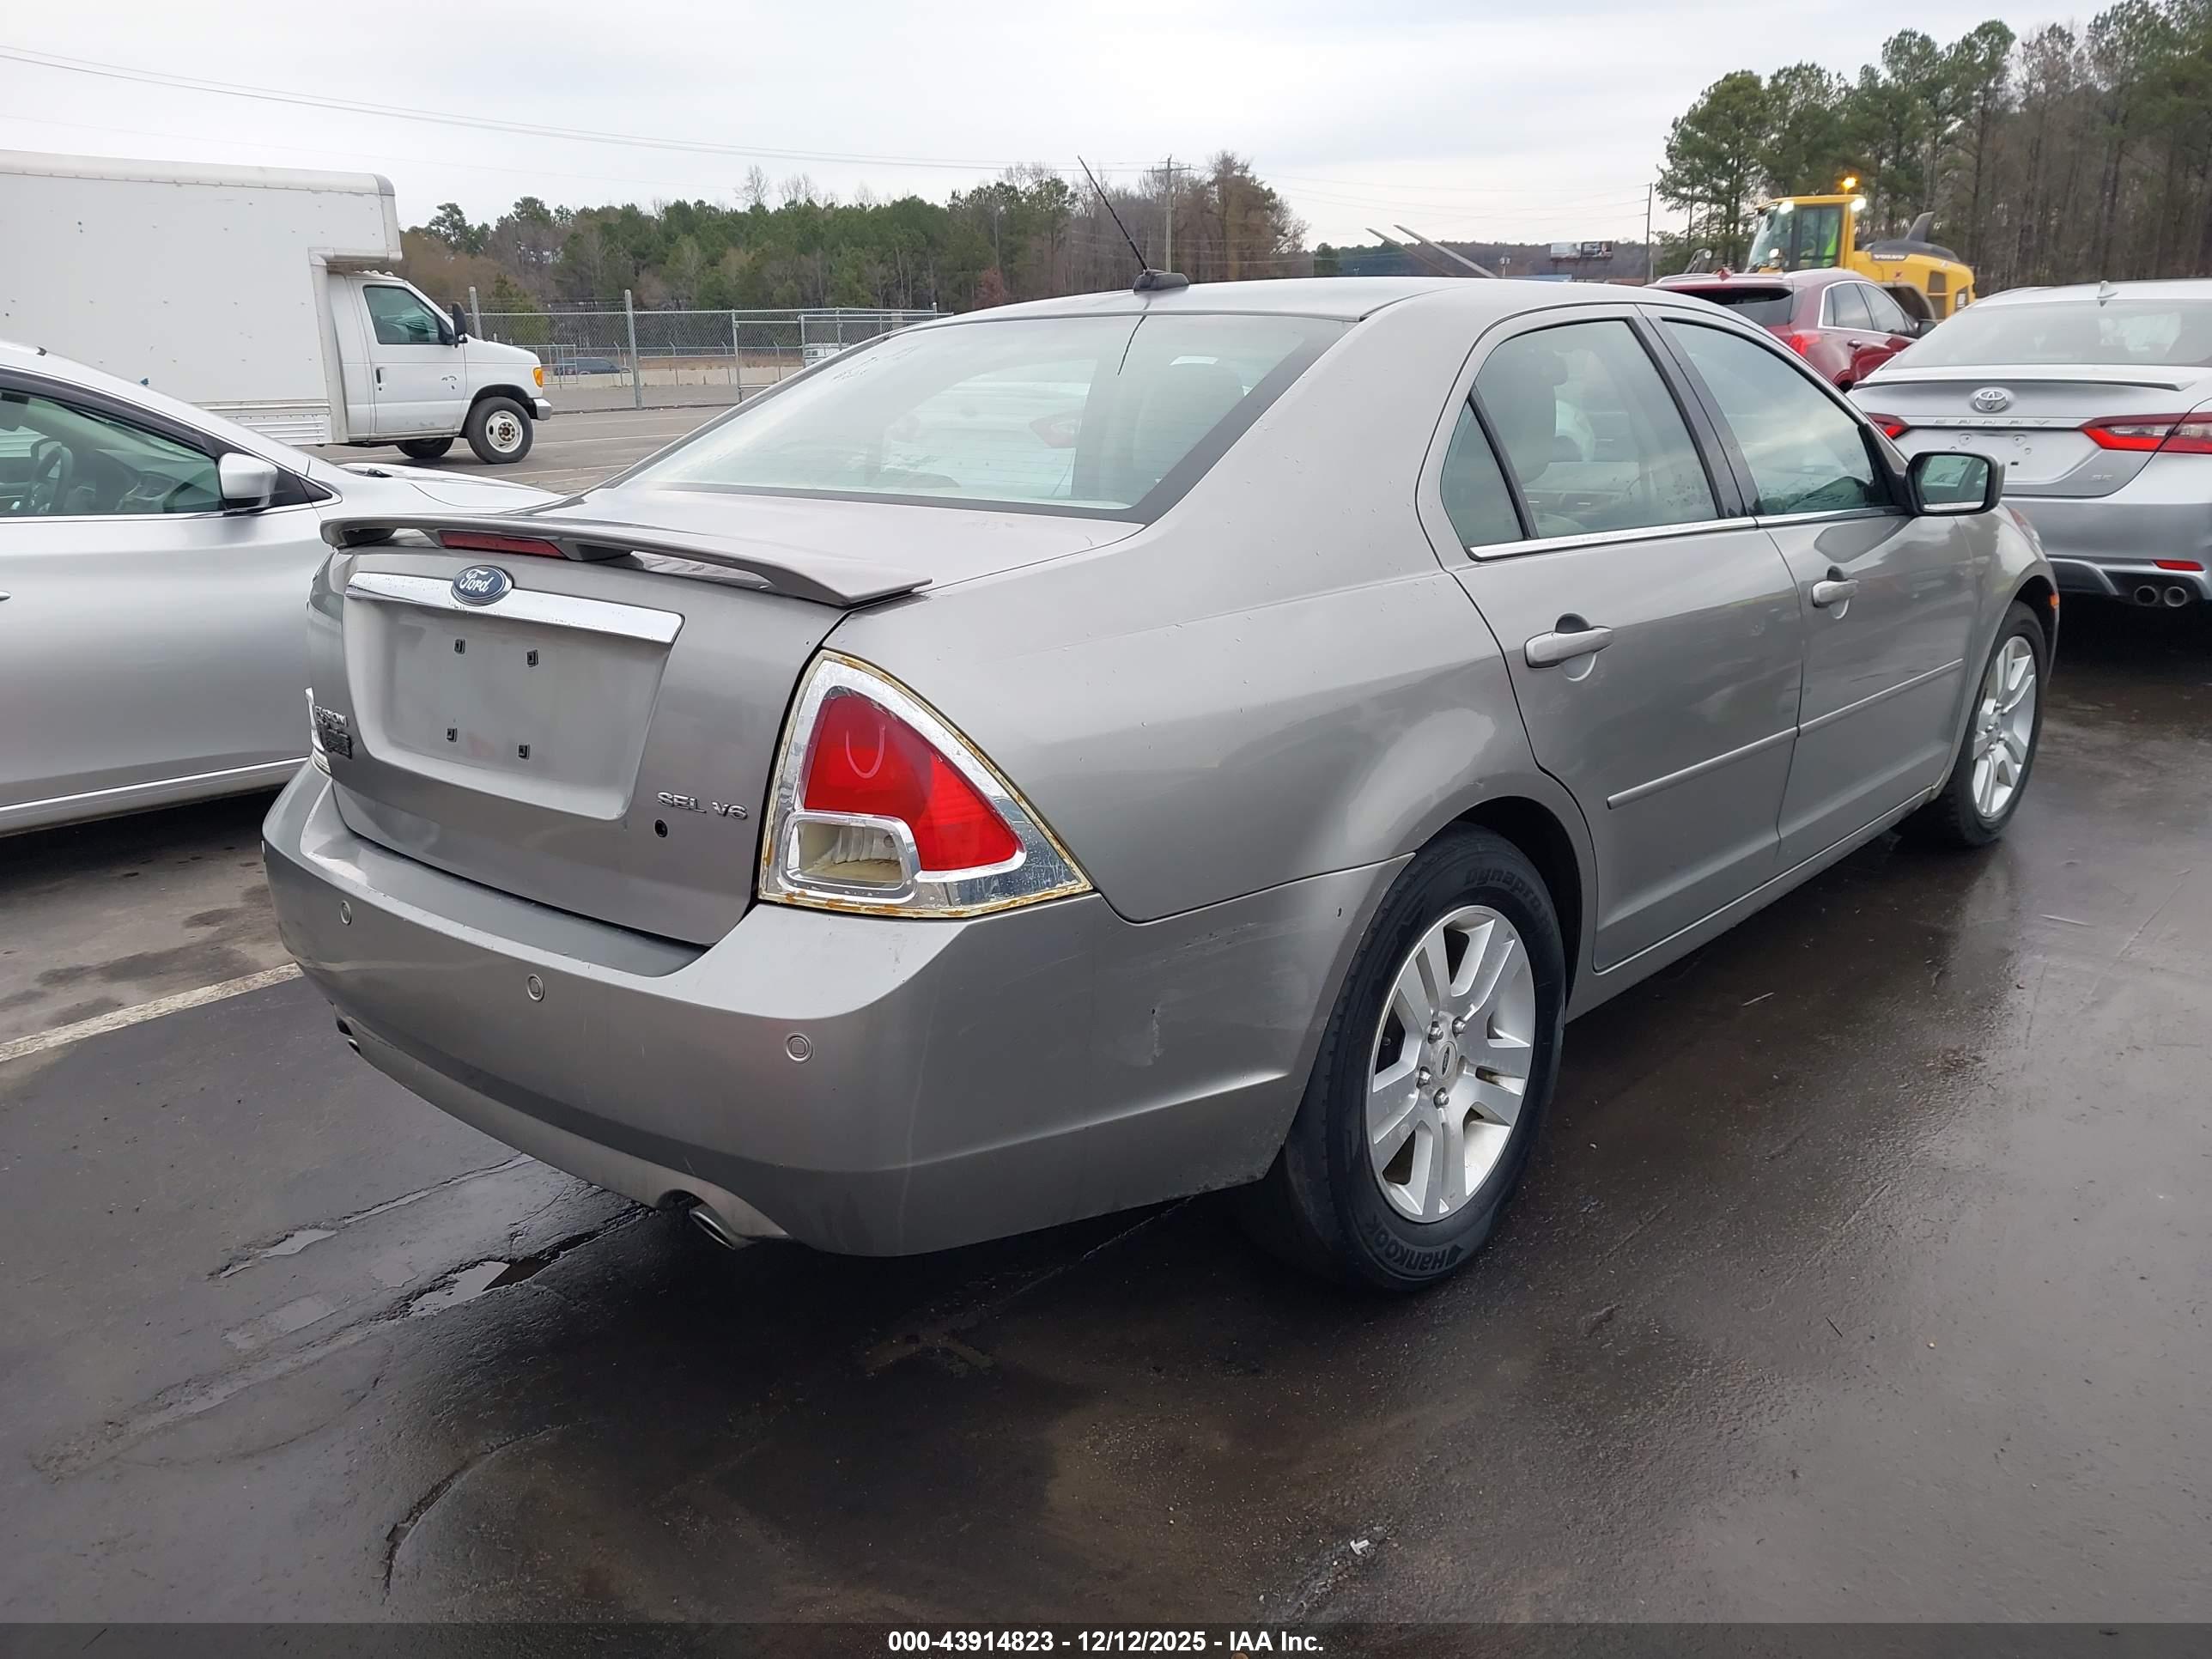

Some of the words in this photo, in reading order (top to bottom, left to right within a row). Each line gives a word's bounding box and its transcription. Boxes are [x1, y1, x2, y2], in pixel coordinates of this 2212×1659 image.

[459, 568, 495, 592] Ford
[657, 792, 707, 813] SEL
[712, 801, 748, 819] V6
